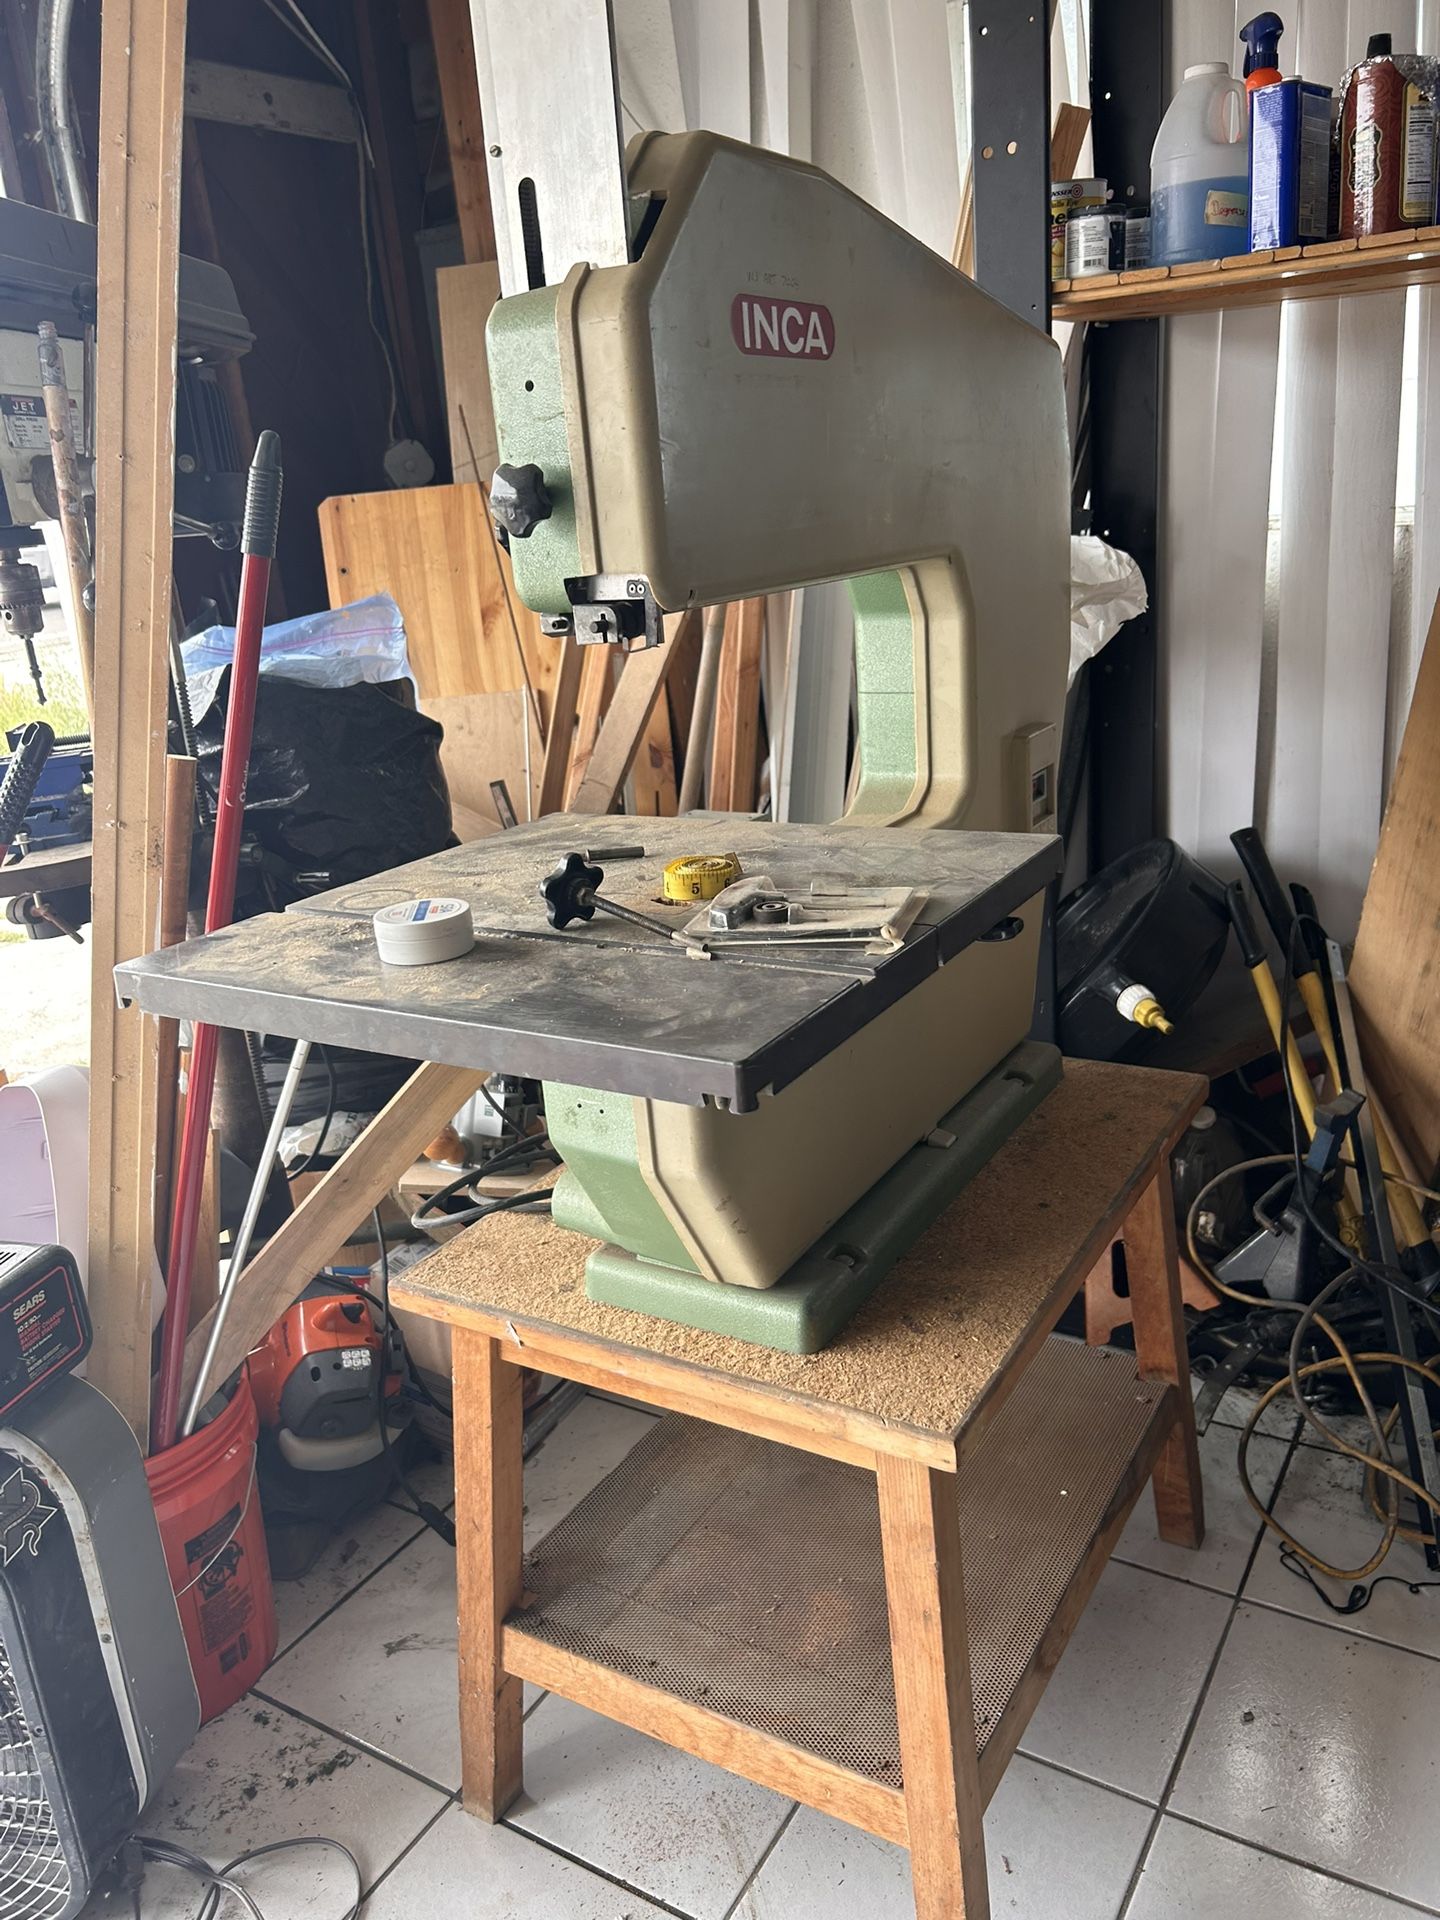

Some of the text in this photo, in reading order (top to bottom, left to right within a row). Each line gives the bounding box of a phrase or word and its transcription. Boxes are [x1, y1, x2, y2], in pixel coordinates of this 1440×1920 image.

[742, 301, 828, 355] INCA
[12, 401, 35, 411] JET
[691, 882, 700, 895] 5
[13, 1289, 46, 1321] SEARS
